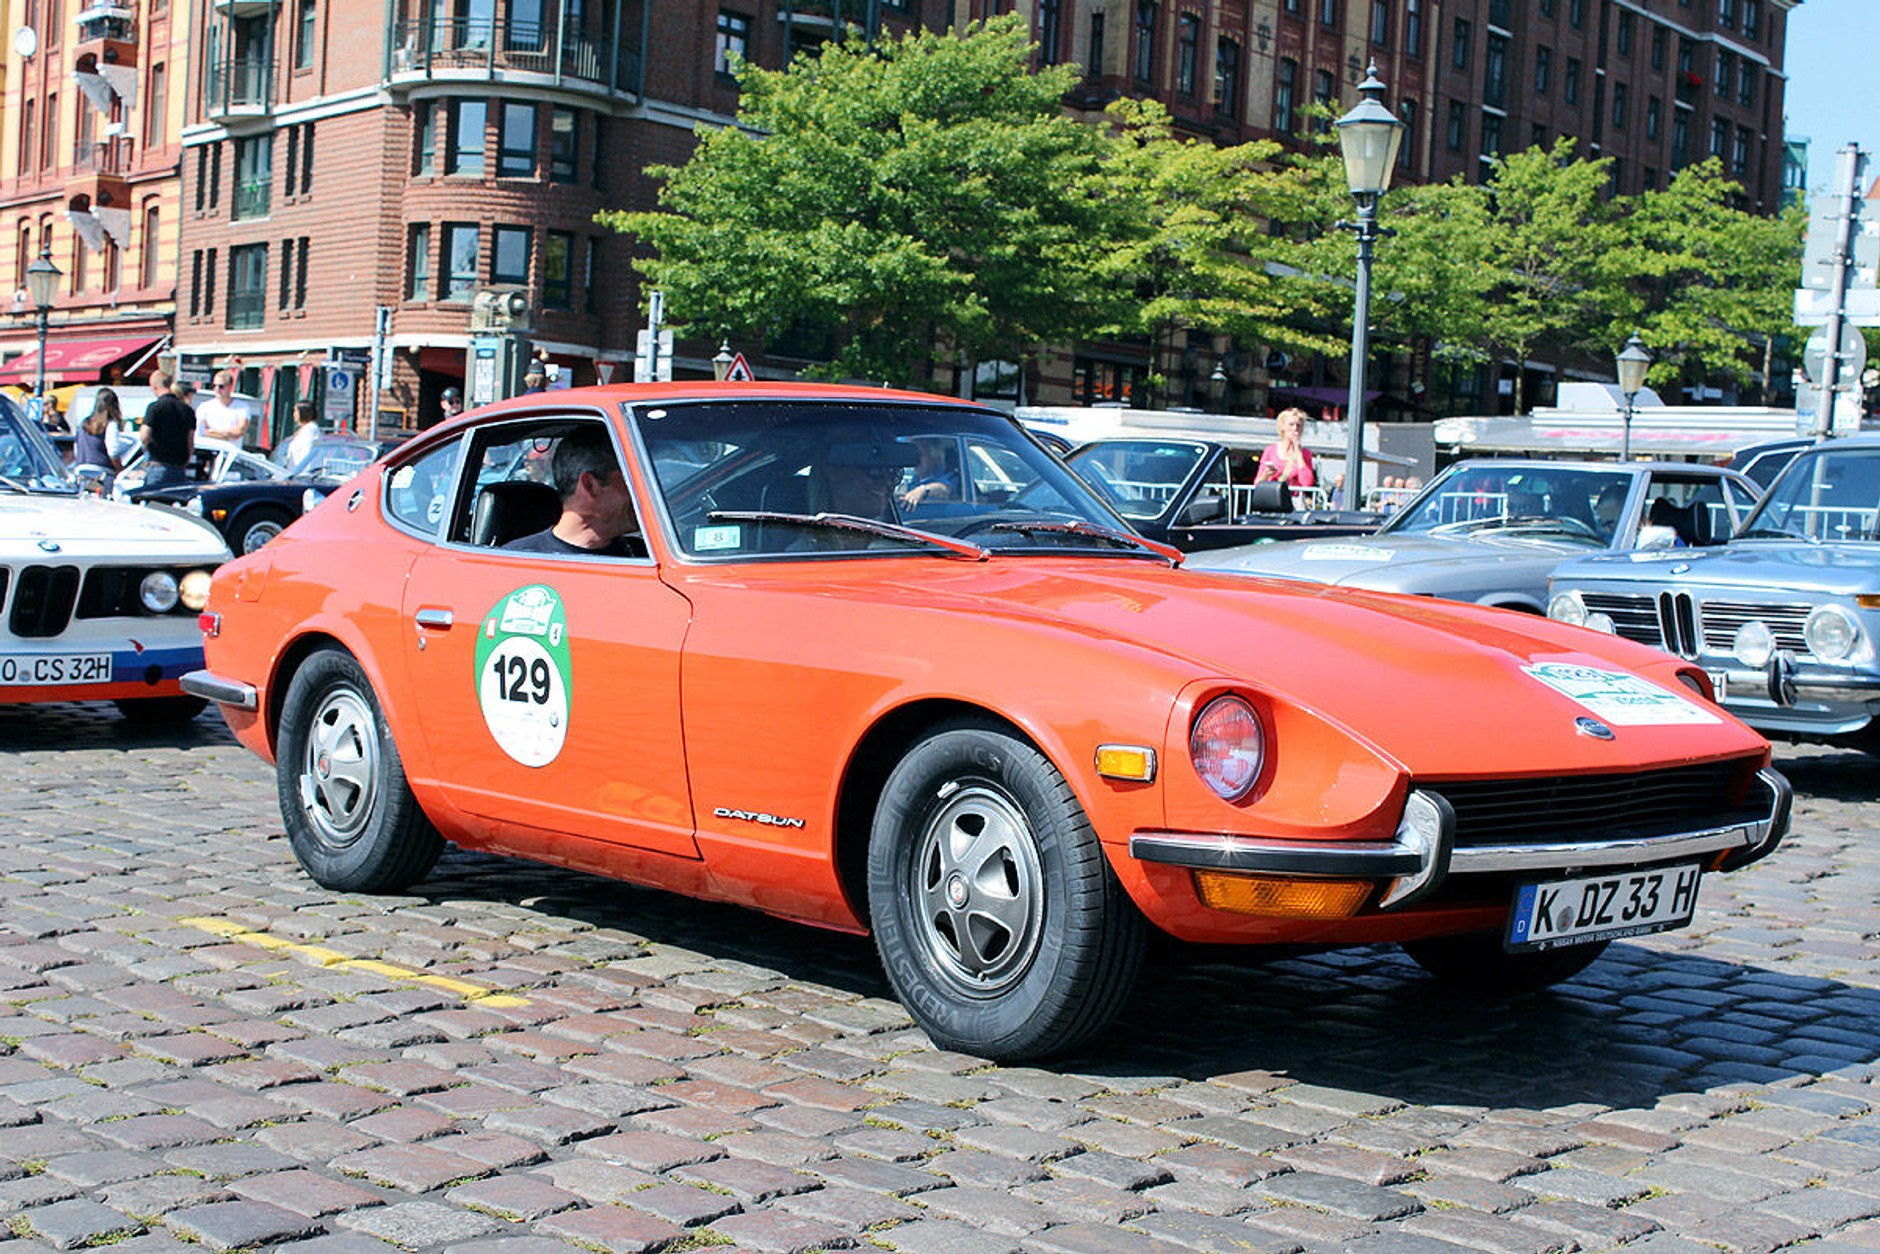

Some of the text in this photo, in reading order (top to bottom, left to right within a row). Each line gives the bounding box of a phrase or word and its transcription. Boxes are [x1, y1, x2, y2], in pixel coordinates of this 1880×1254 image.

[34, 658, 65, 681] CS
[69, 656, 110, 681] 32H
[493, 654, 551, 705] 129
[713, 807, 805, 829] DATSUN
[1533, 869, 1697, 935] K DZ 33 H
[1516, 919, 1526, 934] D
